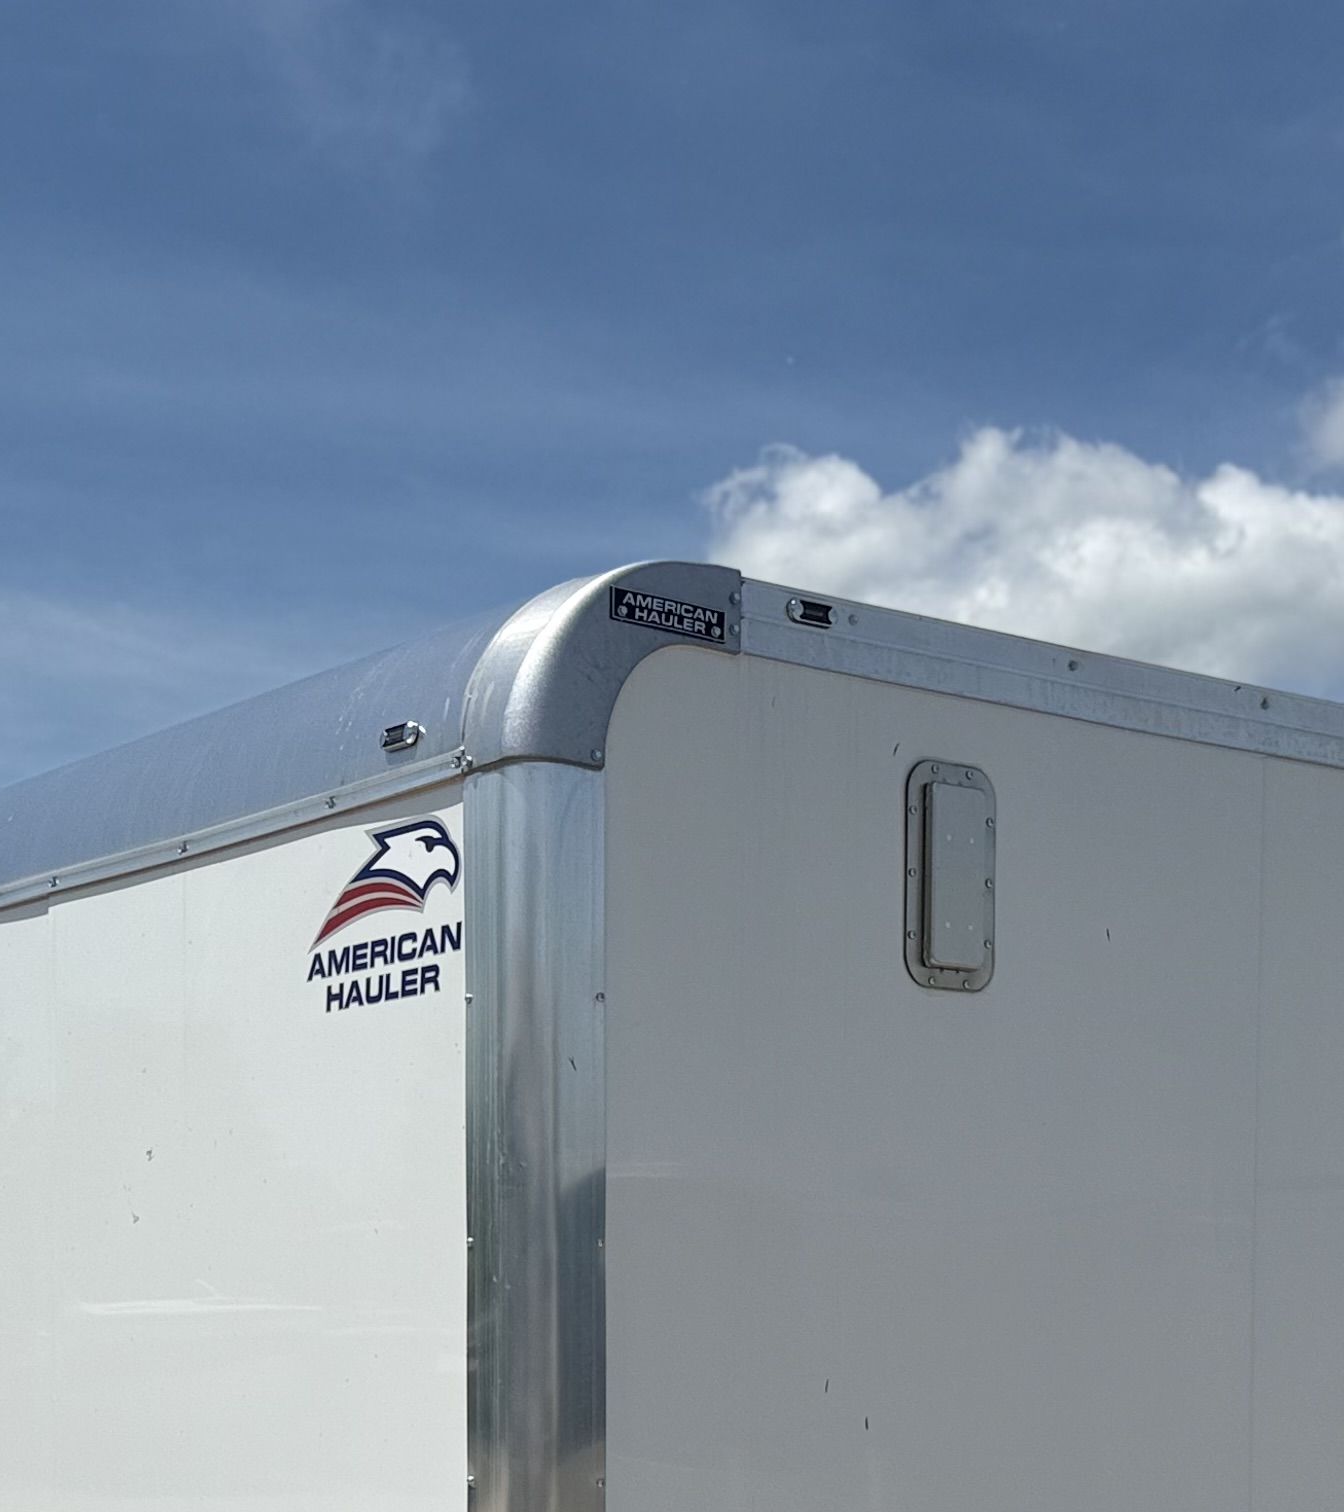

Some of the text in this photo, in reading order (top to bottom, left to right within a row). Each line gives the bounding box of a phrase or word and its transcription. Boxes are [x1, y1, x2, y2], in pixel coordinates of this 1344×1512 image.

[623, 592, 719, 624] AMERICAN
[634, 607, 706, 635] HAULER
[306, 921, 463, 983] AMERICAN
[325, 964, 441, 1013] HAULER
